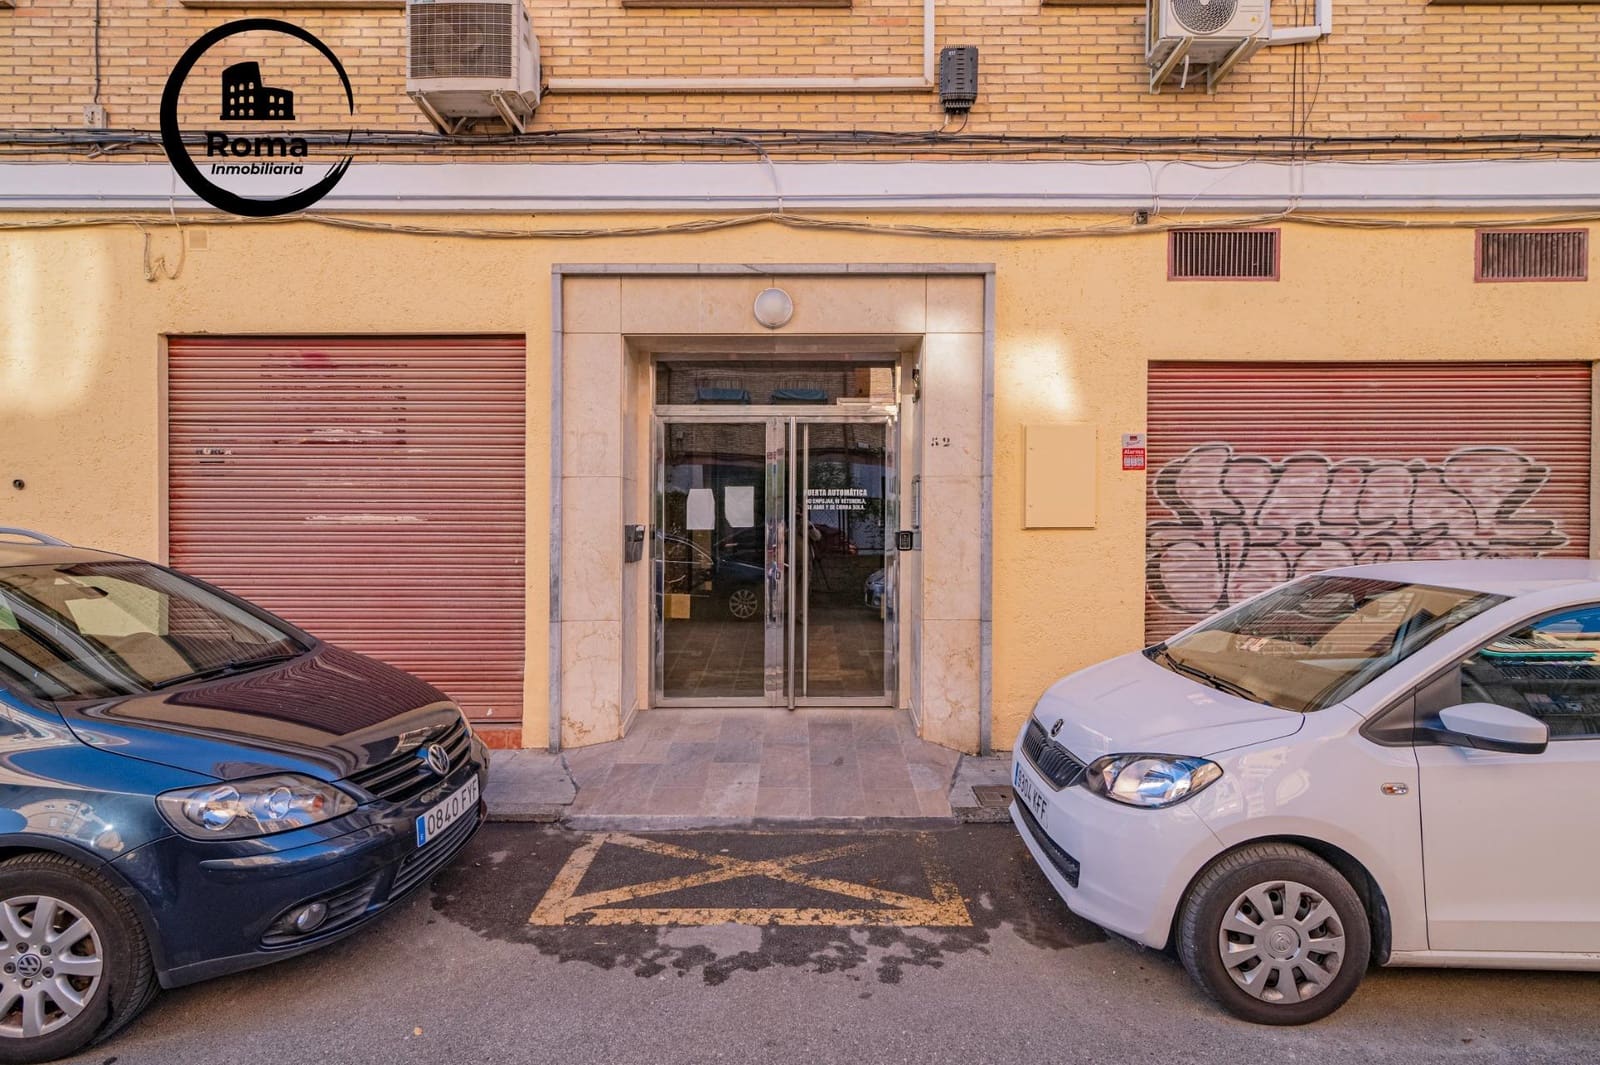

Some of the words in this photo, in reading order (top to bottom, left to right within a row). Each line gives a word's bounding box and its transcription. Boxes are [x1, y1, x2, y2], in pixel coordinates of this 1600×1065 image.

[827, 488, 867, 496] AUTOMÁTICA
[427, 797, 459, 836] 0840
[461, 779, 478, 810] FYF
[1032, 790, 1048, 820] KFF
